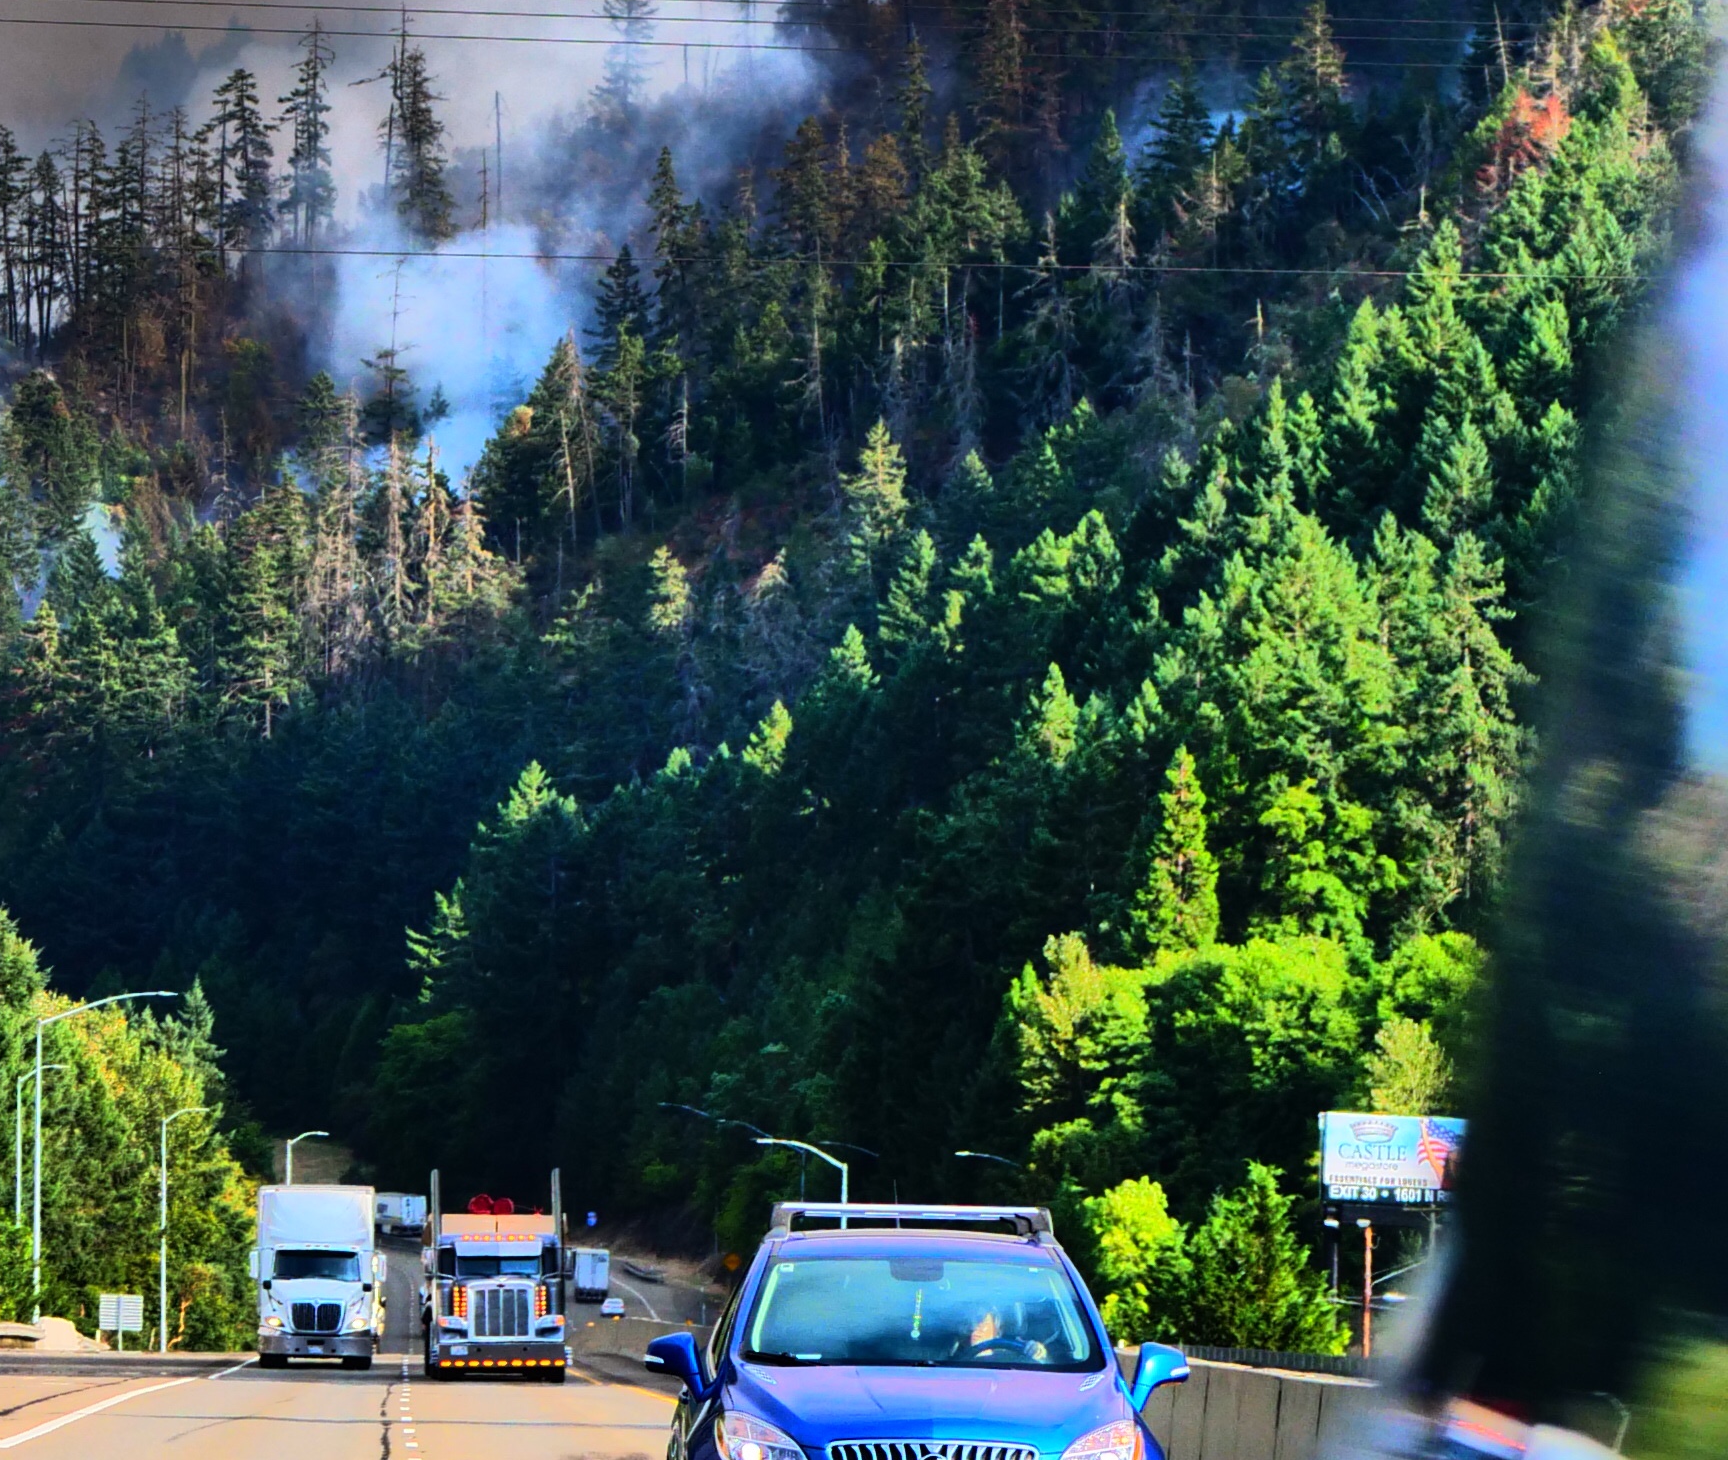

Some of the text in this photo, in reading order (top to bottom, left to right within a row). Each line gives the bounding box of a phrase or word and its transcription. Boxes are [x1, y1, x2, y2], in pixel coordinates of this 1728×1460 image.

[1338, 1143, 1407, 1161] CASTLE
[1345, 1161, 1398, 1171] megastore
[1329, 1174, 1428, 1187] ESSENTIALS FOR LOVERS
[1329, 1186, 1360, 1199] EXIT
[1362, 1187, 1377, 1200] 30
[1394, 1188, 1422, 1202] 1601
[1425, 1189, 1434, 1202] N
